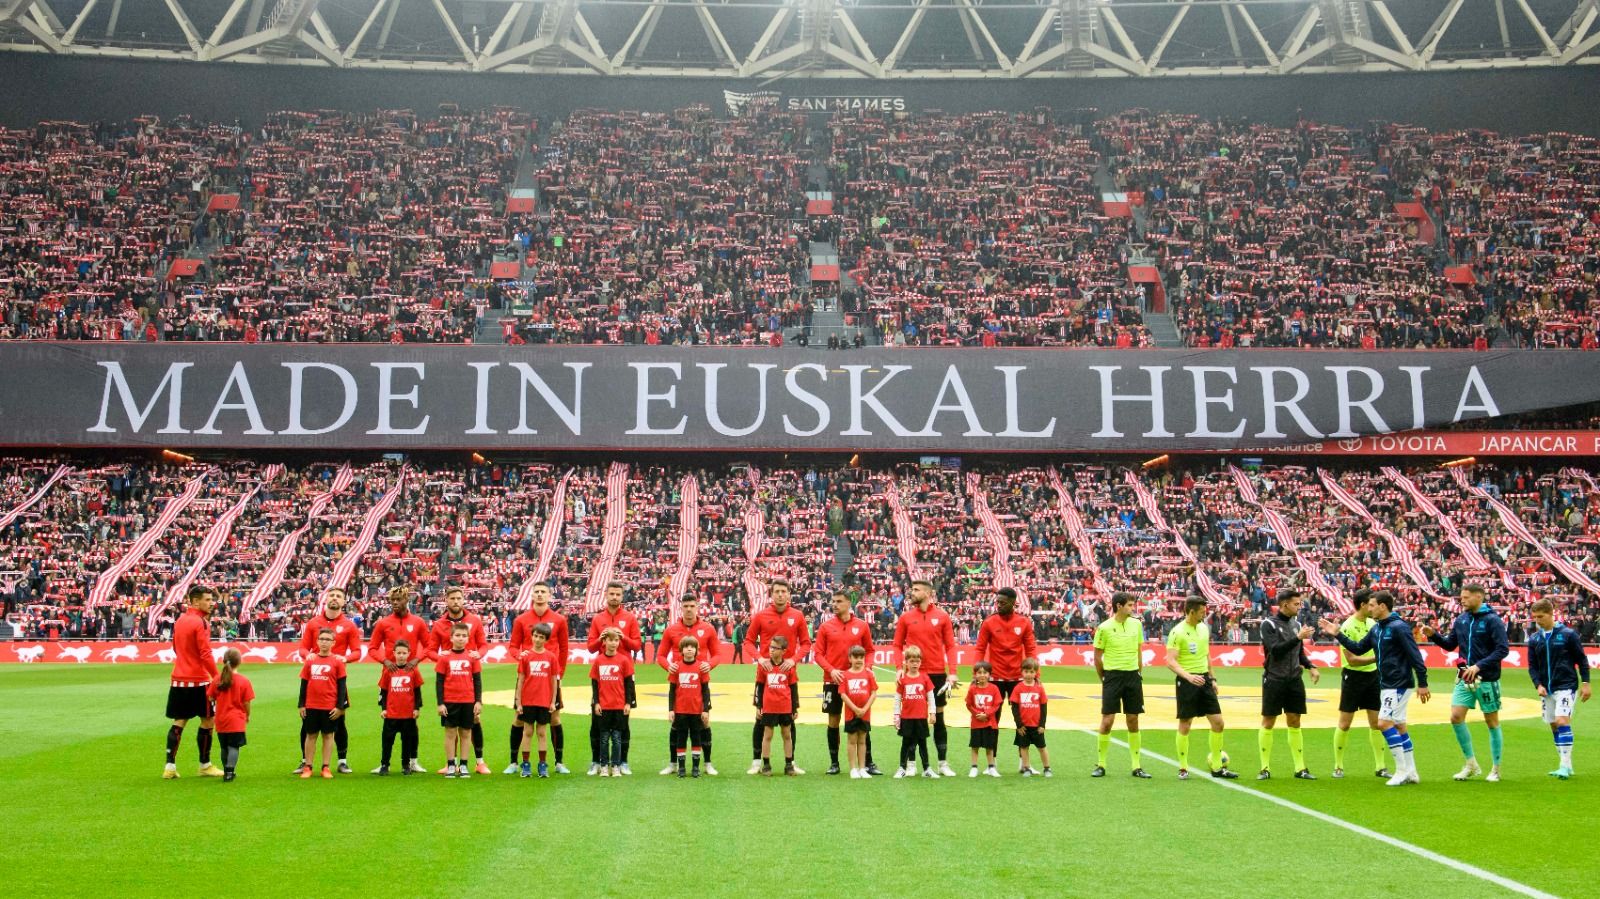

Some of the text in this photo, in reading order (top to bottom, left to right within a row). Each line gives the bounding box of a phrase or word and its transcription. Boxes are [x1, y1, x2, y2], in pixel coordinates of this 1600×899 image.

[788, 98, 906, 111] SAN MAMES
[87, 361, 1501, 438] MADE IN EUSKAL HERRIA
[1370, 436, 1447, 451] TOYOTA
[1479, 436, 1578, 452] JAPANCAR
